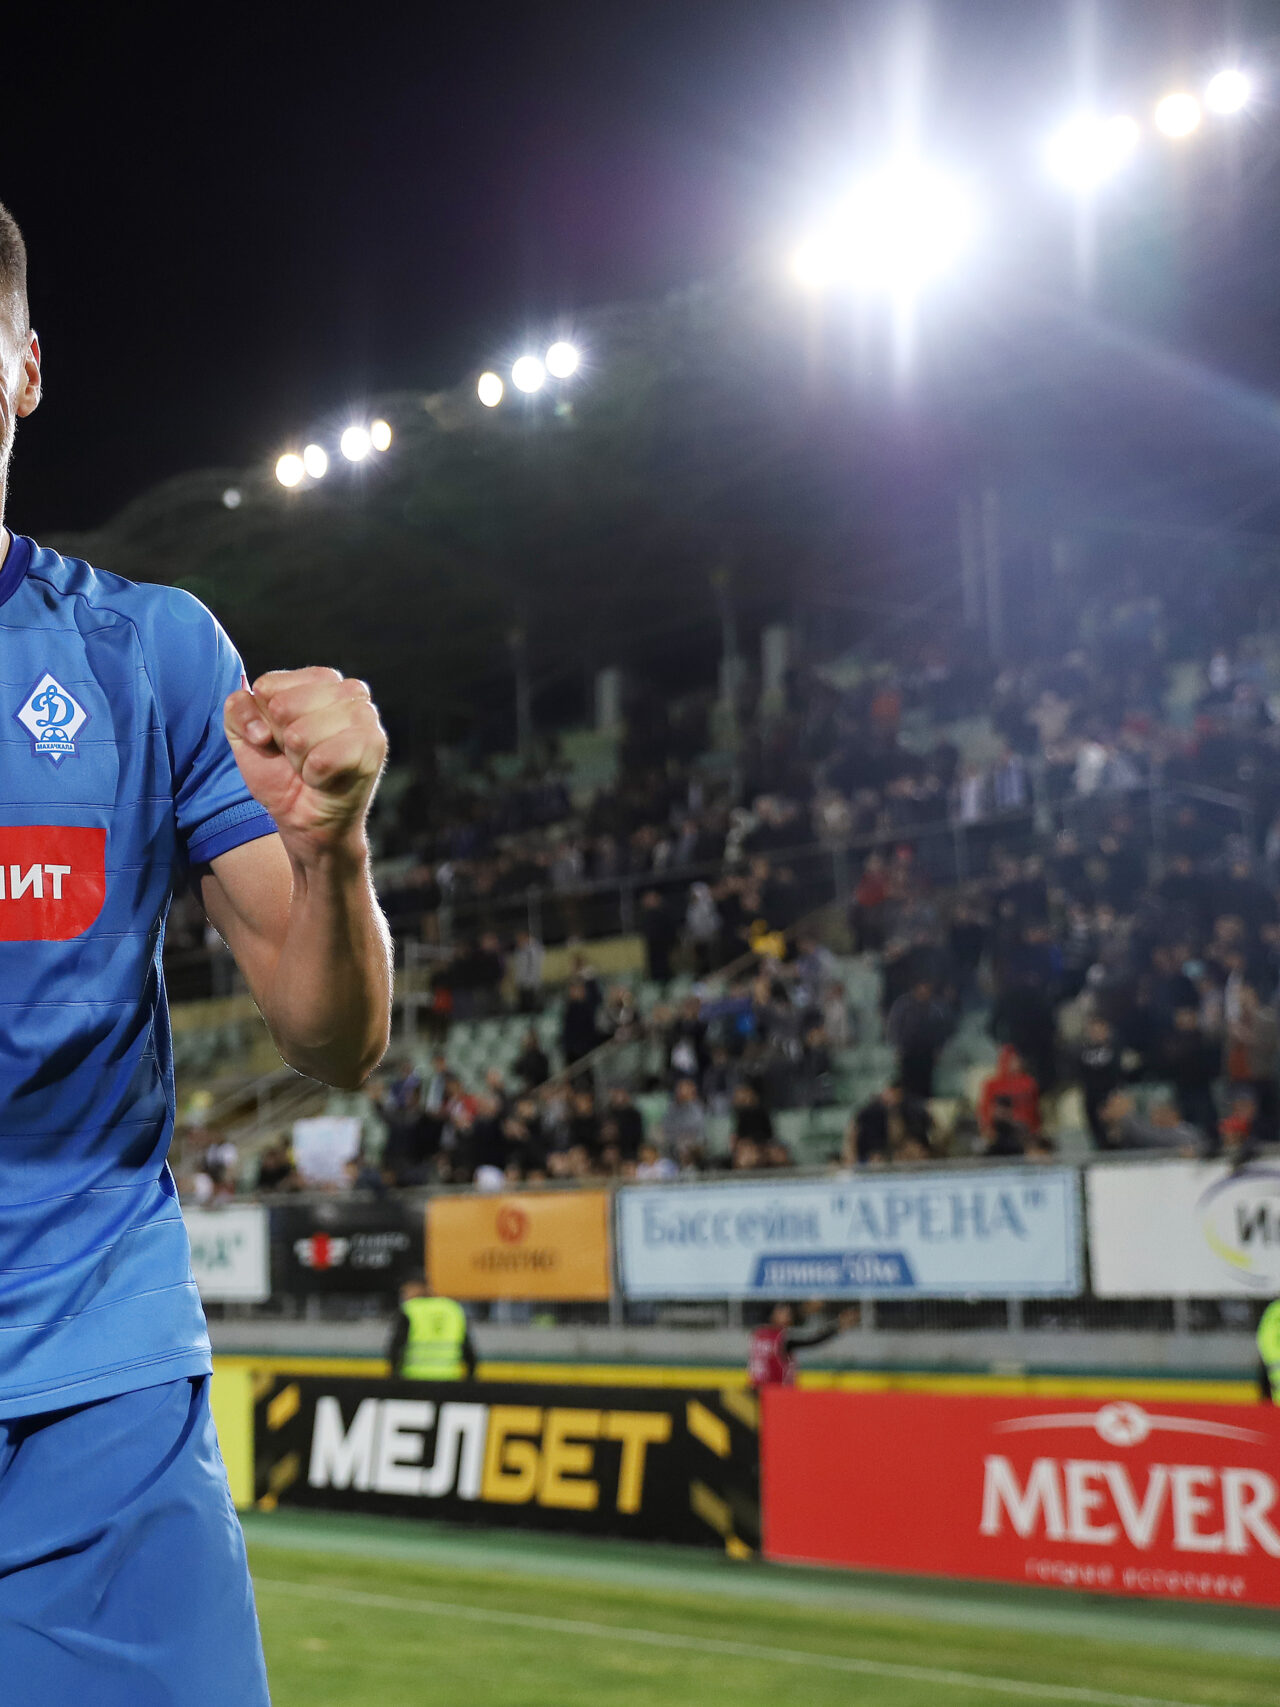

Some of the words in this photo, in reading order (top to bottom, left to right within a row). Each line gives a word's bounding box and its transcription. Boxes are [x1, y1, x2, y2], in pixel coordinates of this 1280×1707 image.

[36, 742, 74, 751] МАХАЧКАЛА
[641, 1200, 821, 1248] Бассейн
[830, 1188, 1047, 1243] "АРЕНА"
[307, 1394, 673, 1515] МЕЛБЕТ
[978, 1454, 1280, 1560] MEVER
